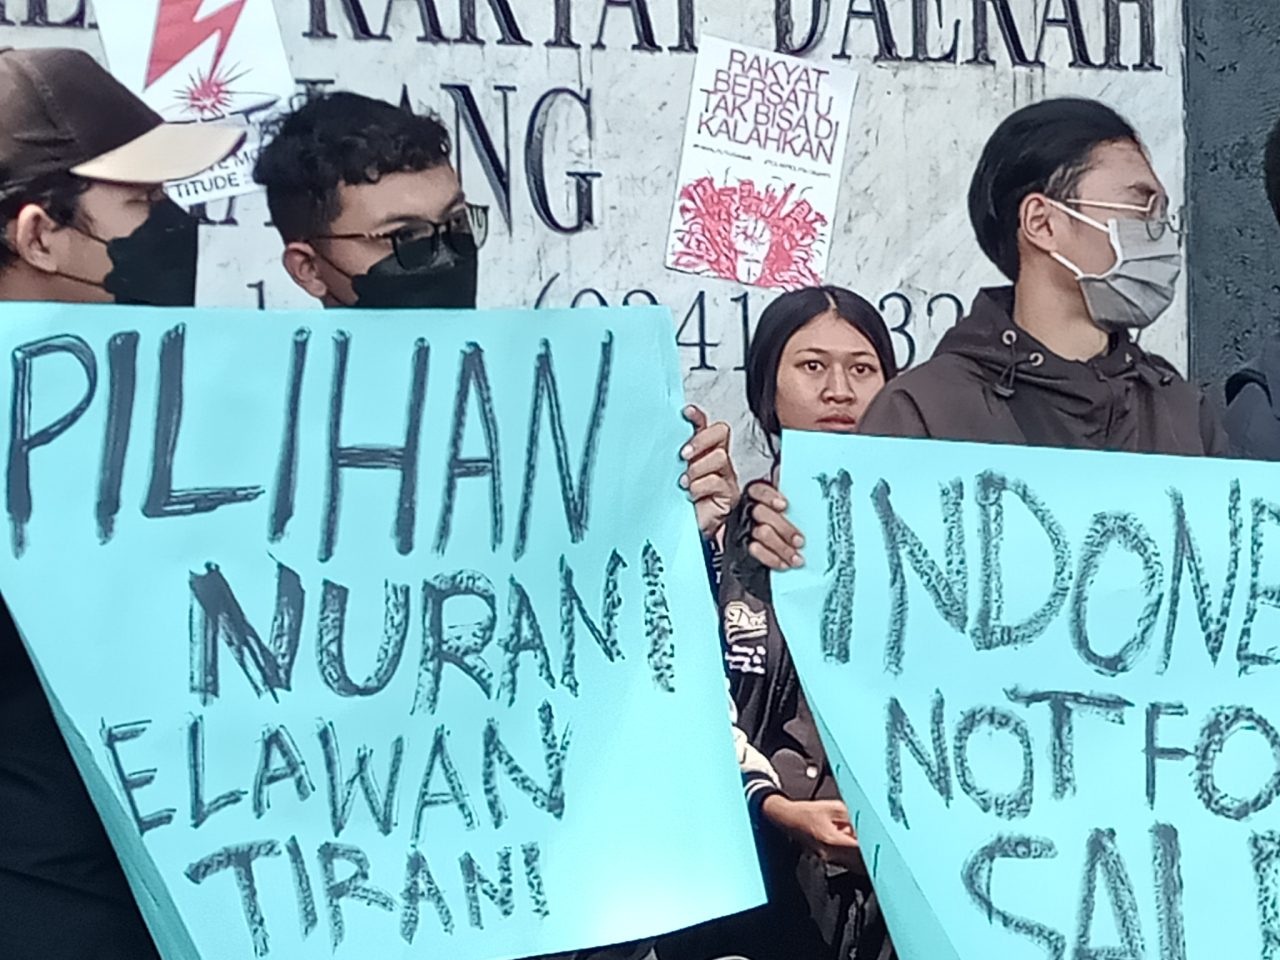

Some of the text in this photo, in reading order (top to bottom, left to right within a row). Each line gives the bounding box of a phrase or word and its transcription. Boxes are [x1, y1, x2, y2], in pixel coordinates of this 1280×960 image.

[714, 69, 833, 117] BERSATU
[728, 49, 829, 91] RAKYAT
[698, 113, 833, 164] KALAHKAN
[700, 88, 839, 147] TAK BISA DI
[6, 323, 613, 562] PILIHAN
[189, 540, 675, 716] NURANI
[884, 686, 1134, 829] NOT
